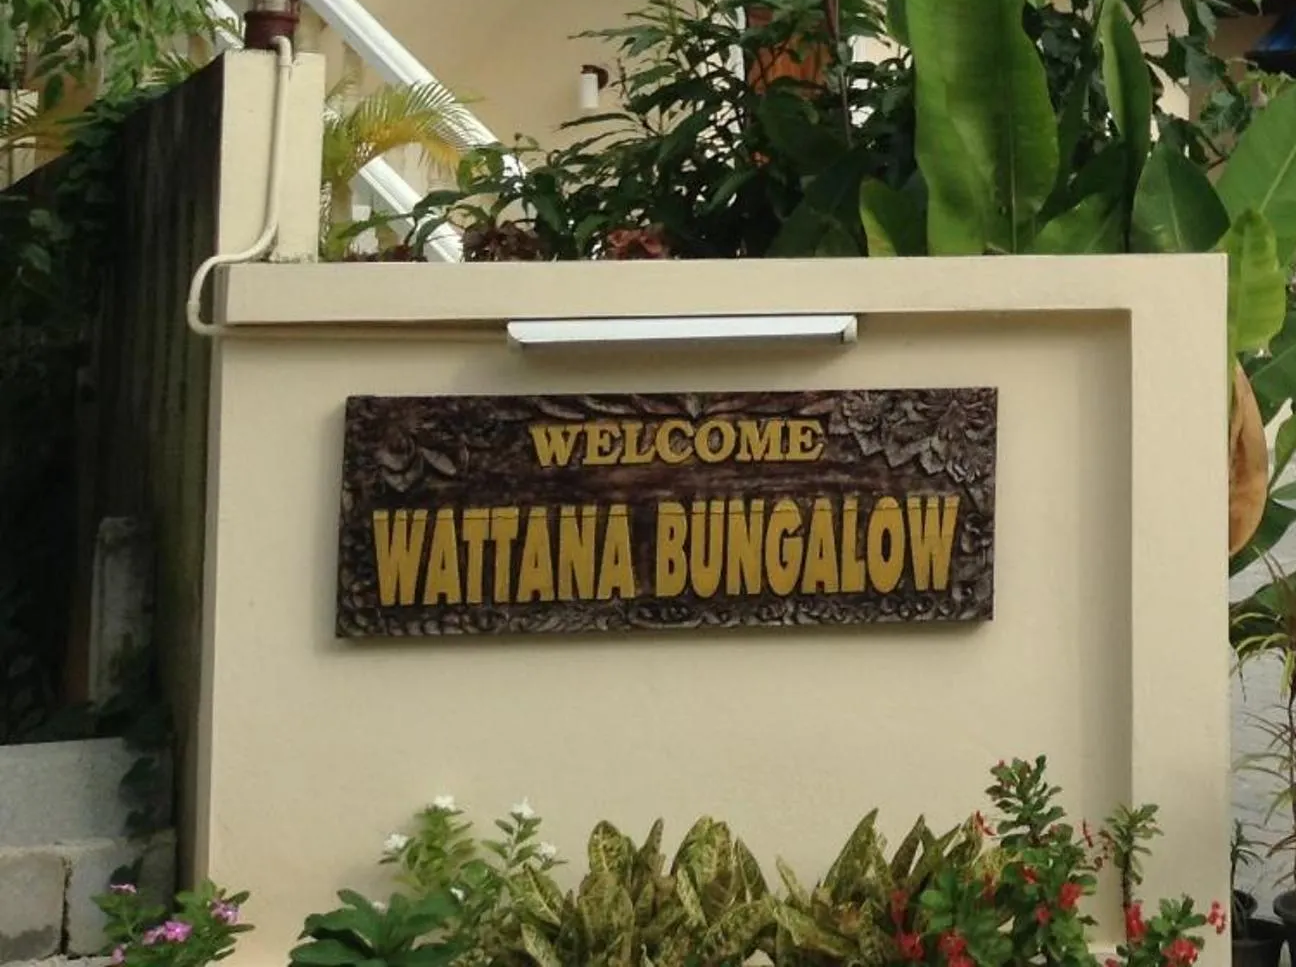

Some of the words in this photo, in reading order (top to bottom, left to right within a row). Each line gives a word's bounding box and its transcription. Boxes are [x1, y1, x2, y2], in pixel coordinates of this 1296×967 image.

[530, 419, 824, 467] WELCOME
[373, 503, 636, 606] WATTANA
[655, 495, 960, 598] BUNGALOW
